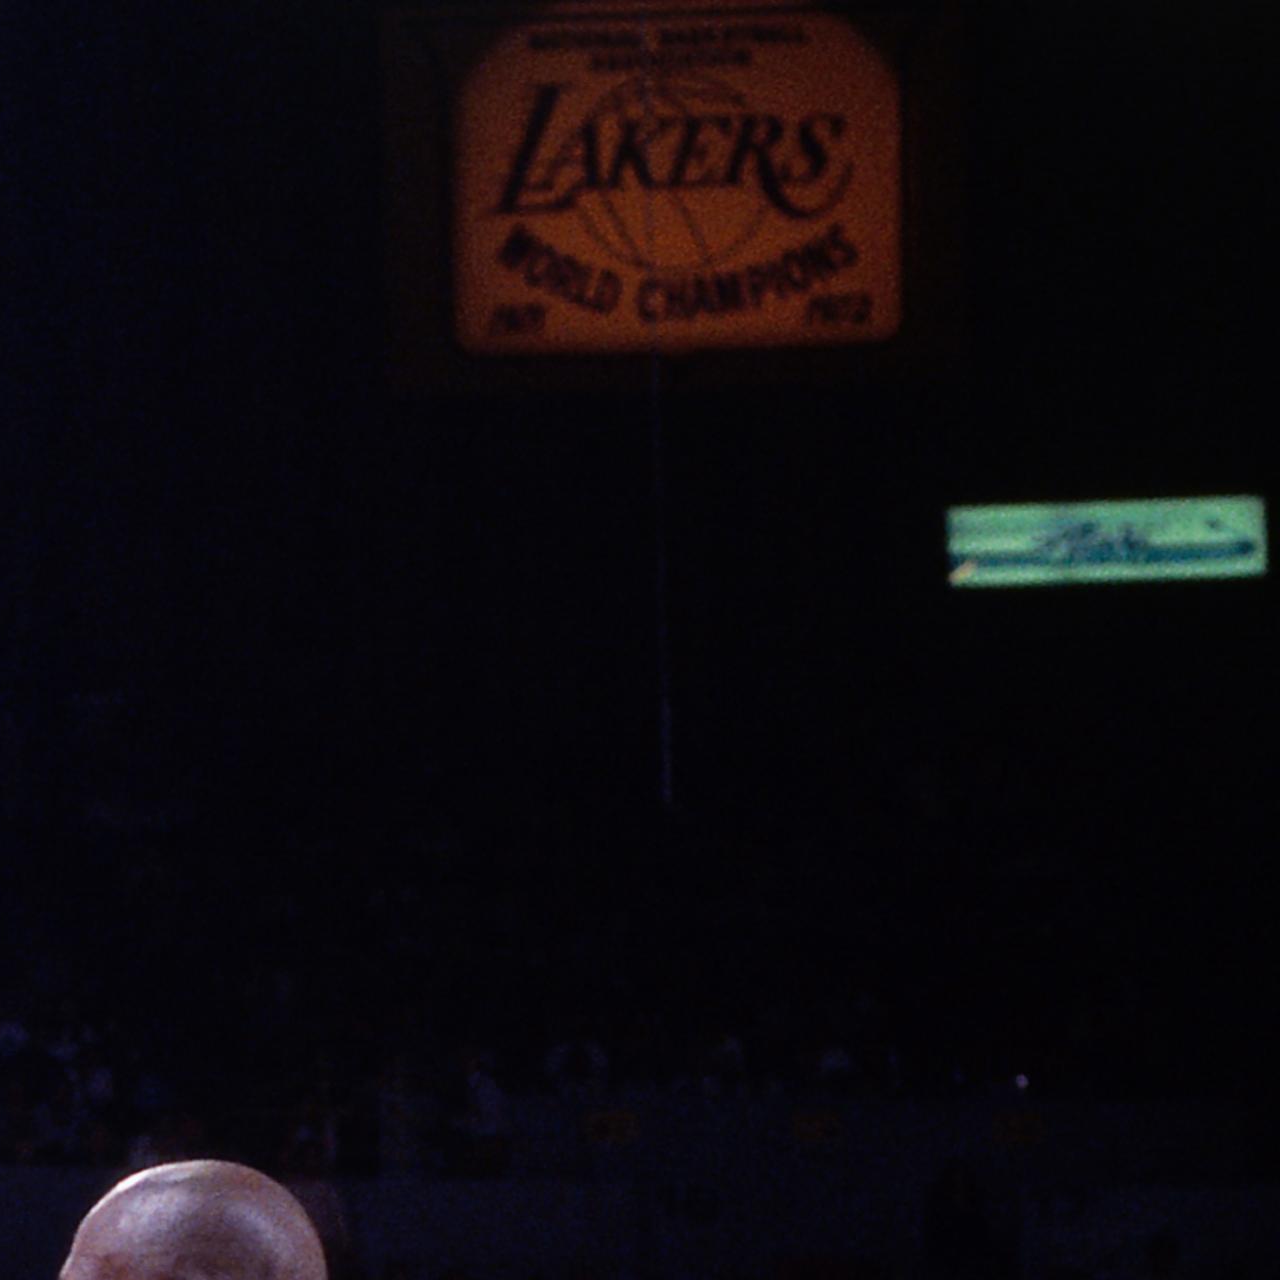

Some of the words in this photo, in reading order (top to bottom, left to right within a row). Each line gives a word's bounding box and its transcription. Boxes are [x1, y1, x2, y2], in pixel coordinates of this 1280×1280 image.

[486, 82, 855, 219] LAKERS
[496, 223, 622, 315] WORLD
[636, 223, 860, 324] CHAMPIONS
